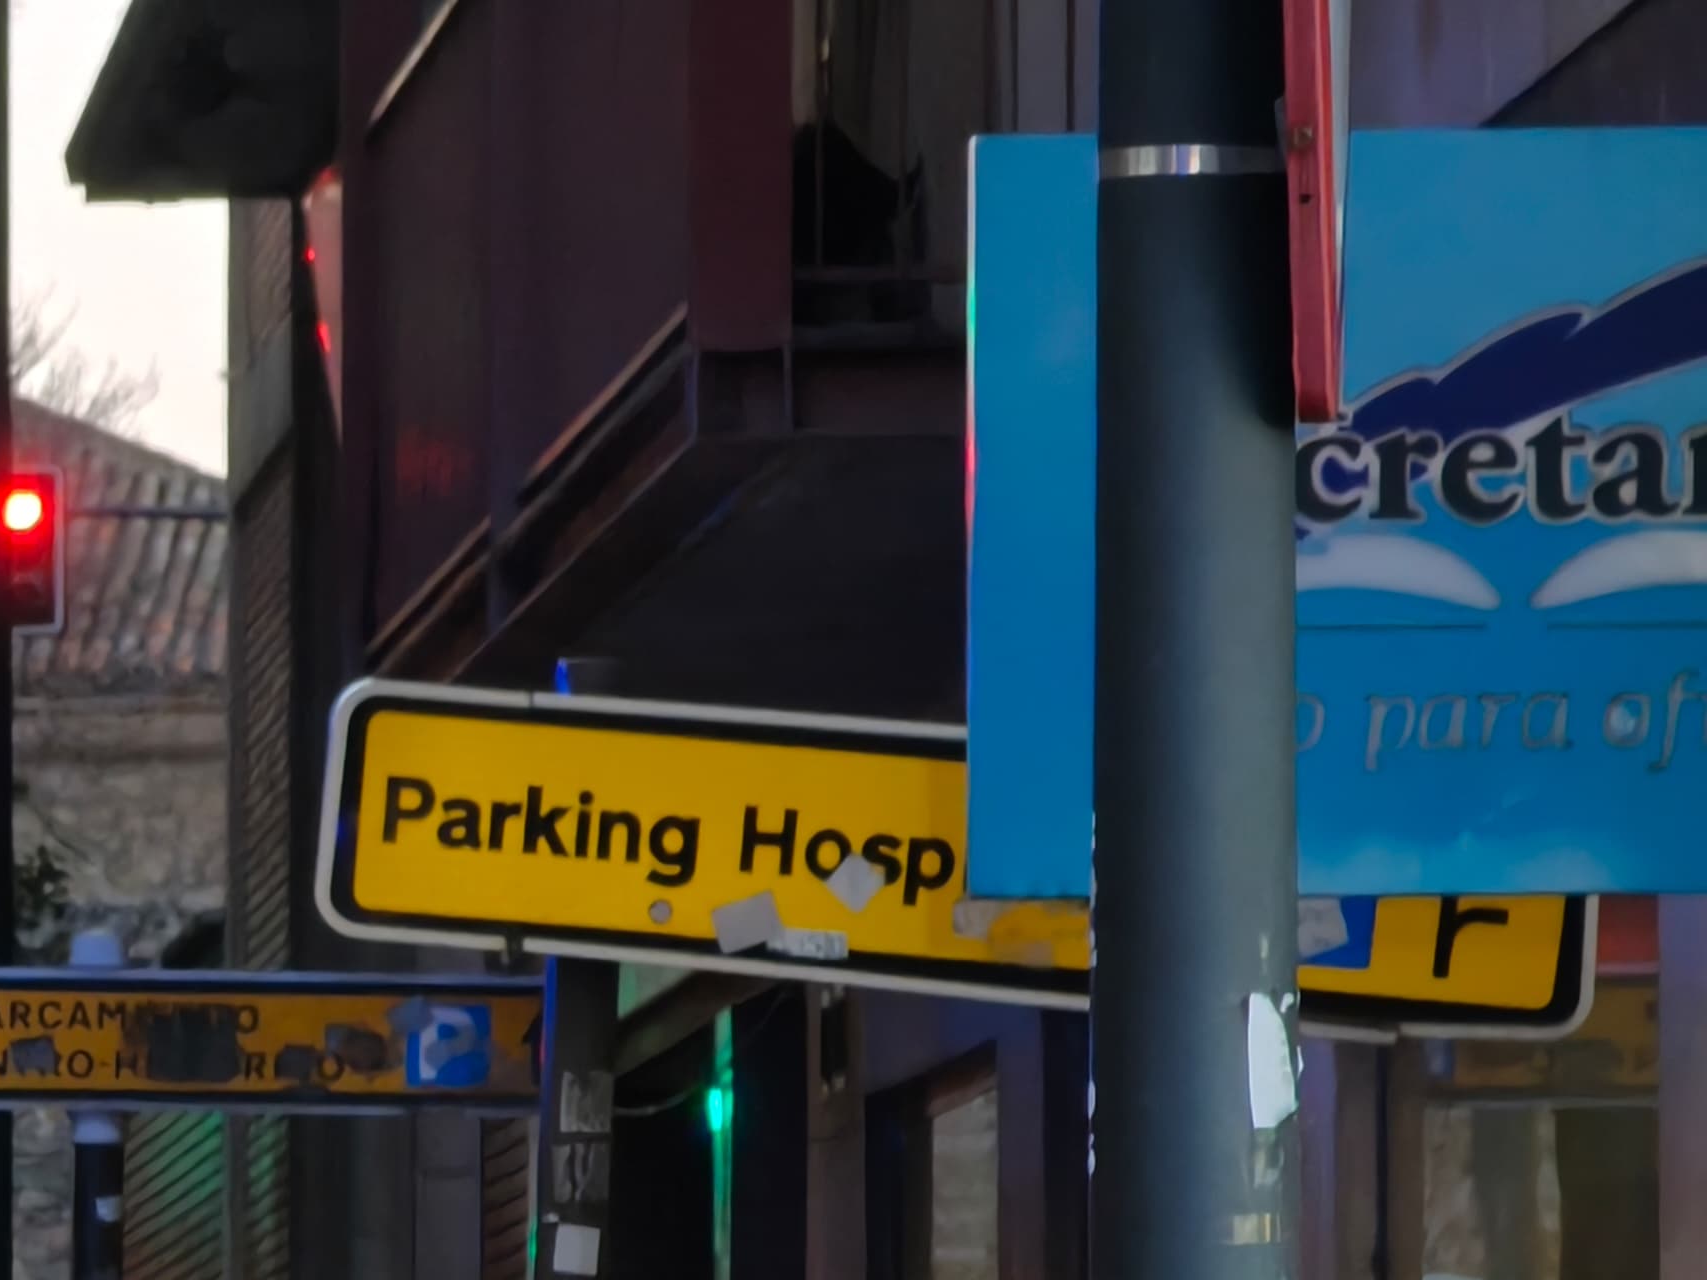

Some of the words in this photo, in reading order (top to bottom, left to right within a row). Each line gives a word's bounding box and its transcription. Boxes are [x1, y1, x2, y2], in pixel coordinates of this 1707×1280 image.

[1365, 692, 1573, 771] para
[383, 776, 699, 888] Parking
[740, 806, 957, 905] Hosp
